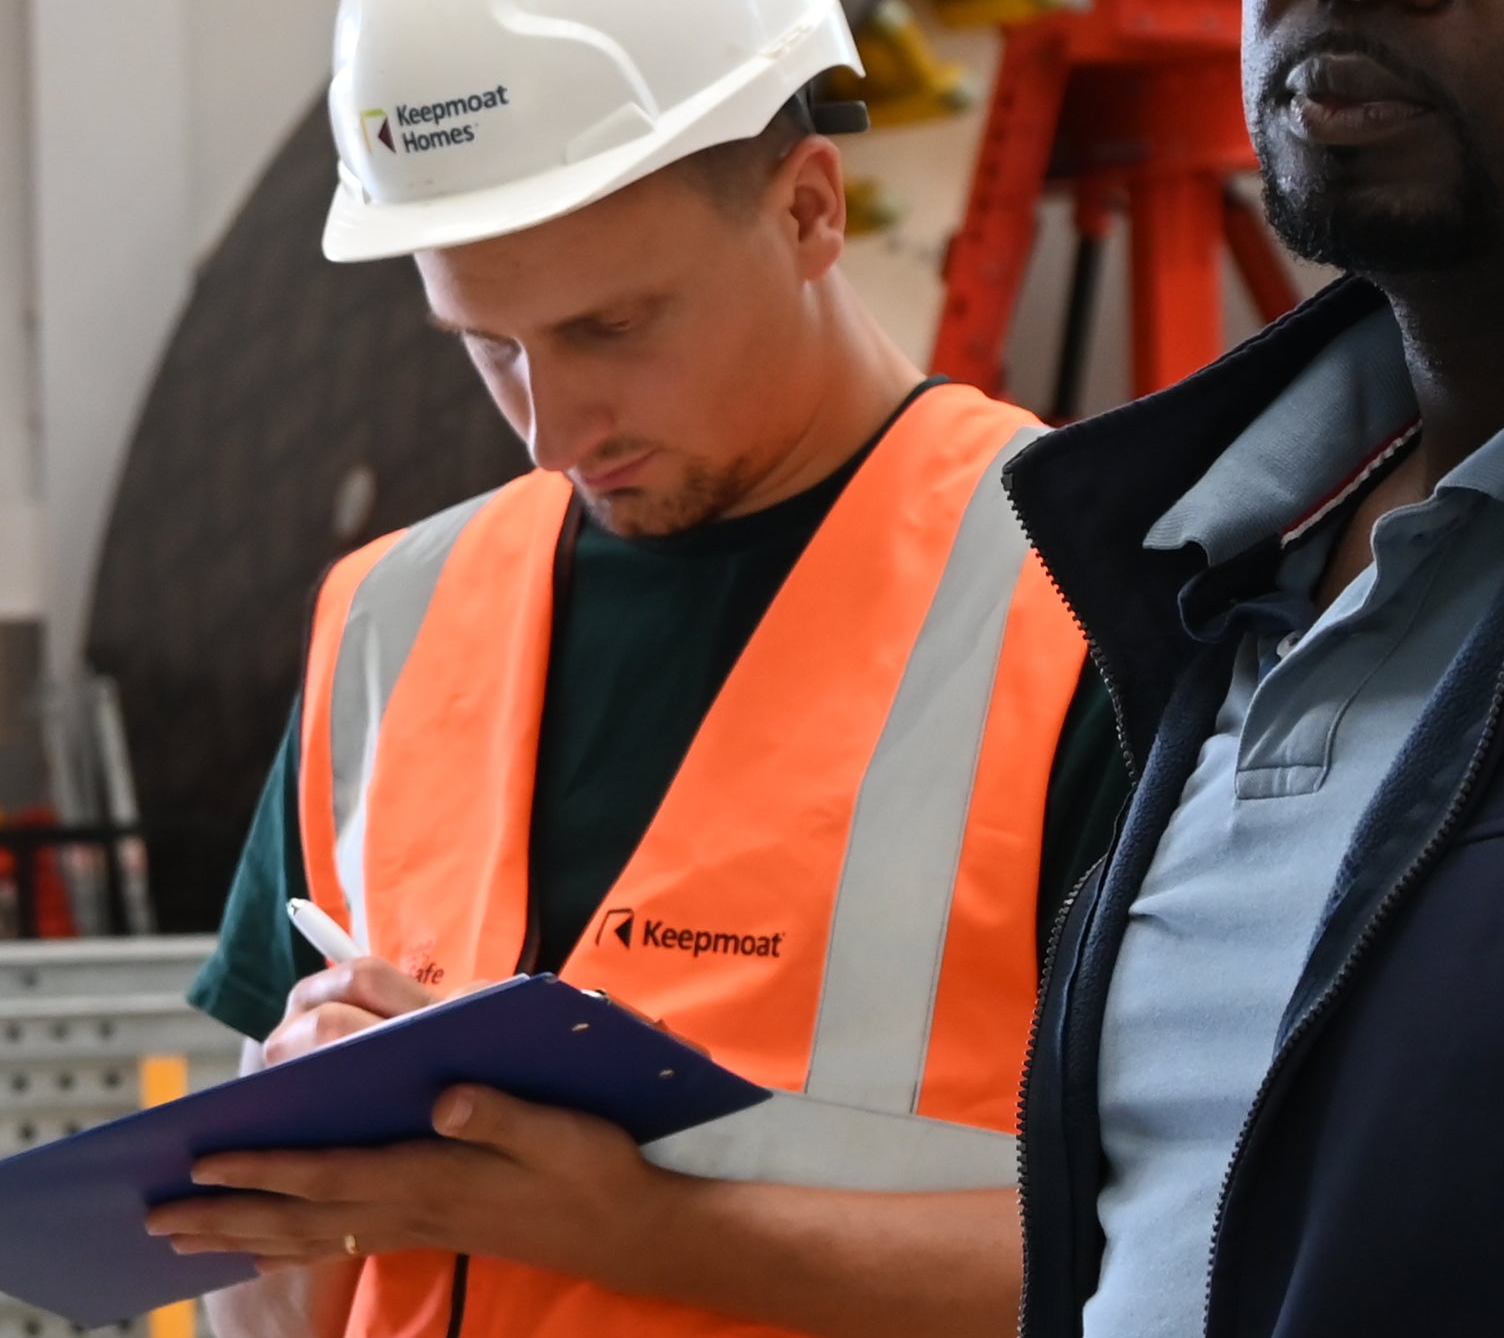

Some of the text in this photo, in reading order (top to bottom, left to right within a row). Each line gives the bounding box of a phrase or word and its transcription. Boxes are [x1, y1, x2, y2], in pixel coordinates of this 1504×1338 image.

[396, 85, 508, 127] Keepmoat
[402, 124, 475, 154] Homes
[642, 919, 782, 958] Keepmoat
